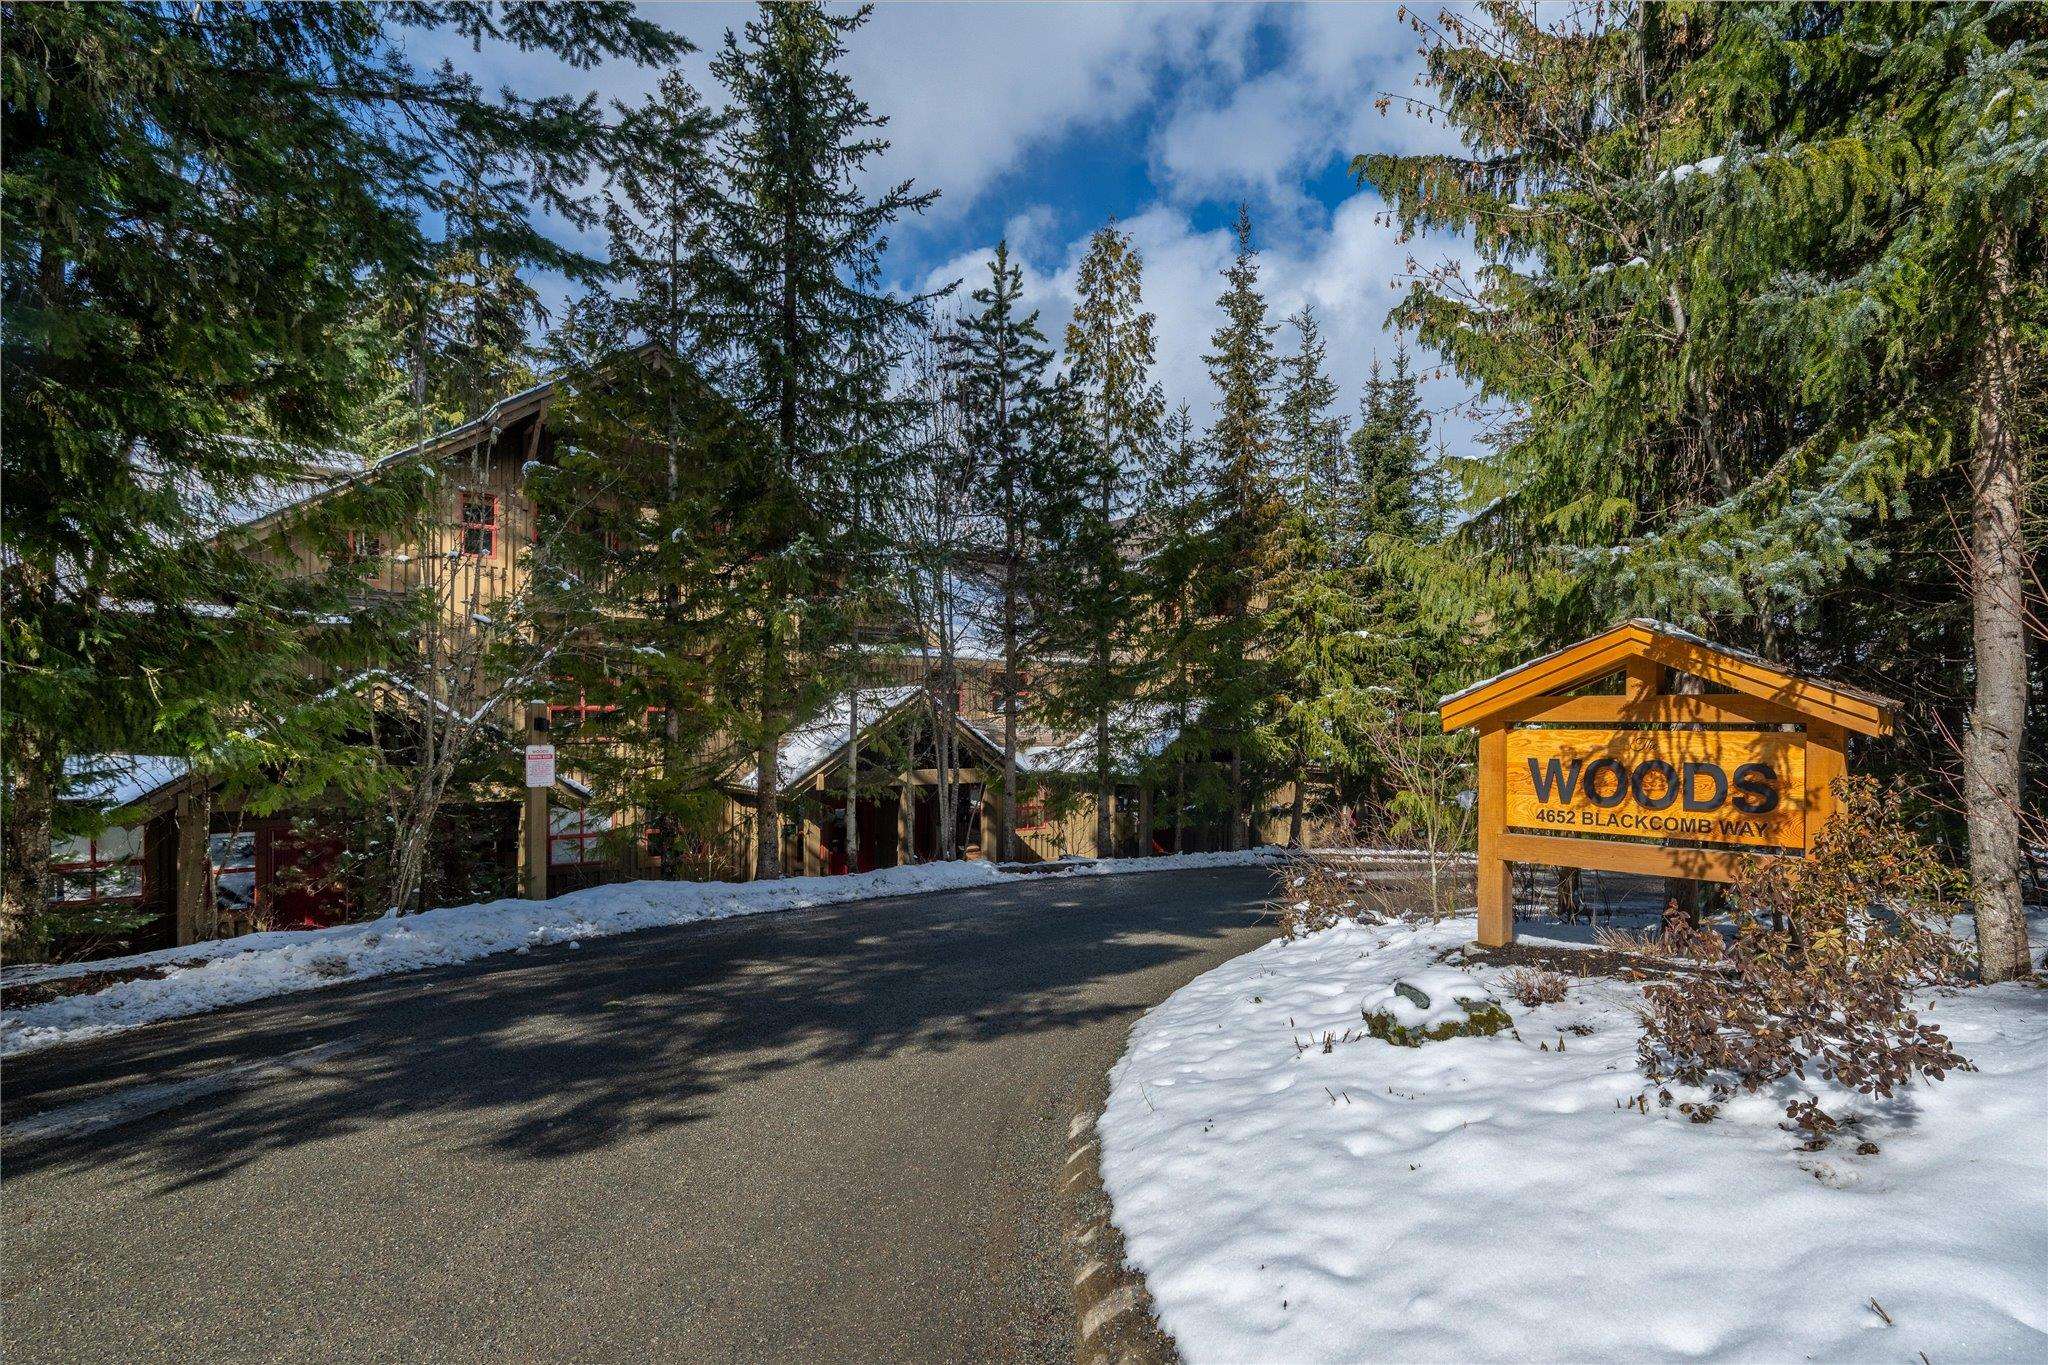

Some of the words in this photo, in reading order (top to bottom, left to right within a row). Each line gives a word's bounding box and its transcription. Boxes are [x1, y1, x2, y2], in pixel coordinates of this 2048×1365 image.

[1630, 736, 1658, 752] The
[1527, 757, 1780, 815] WOODS
[1536, 808, 1576, 825] 4652
[1581, 811, 1713, 834] BLACKCOMB
[1719, 819, 1769, 838] WAY
